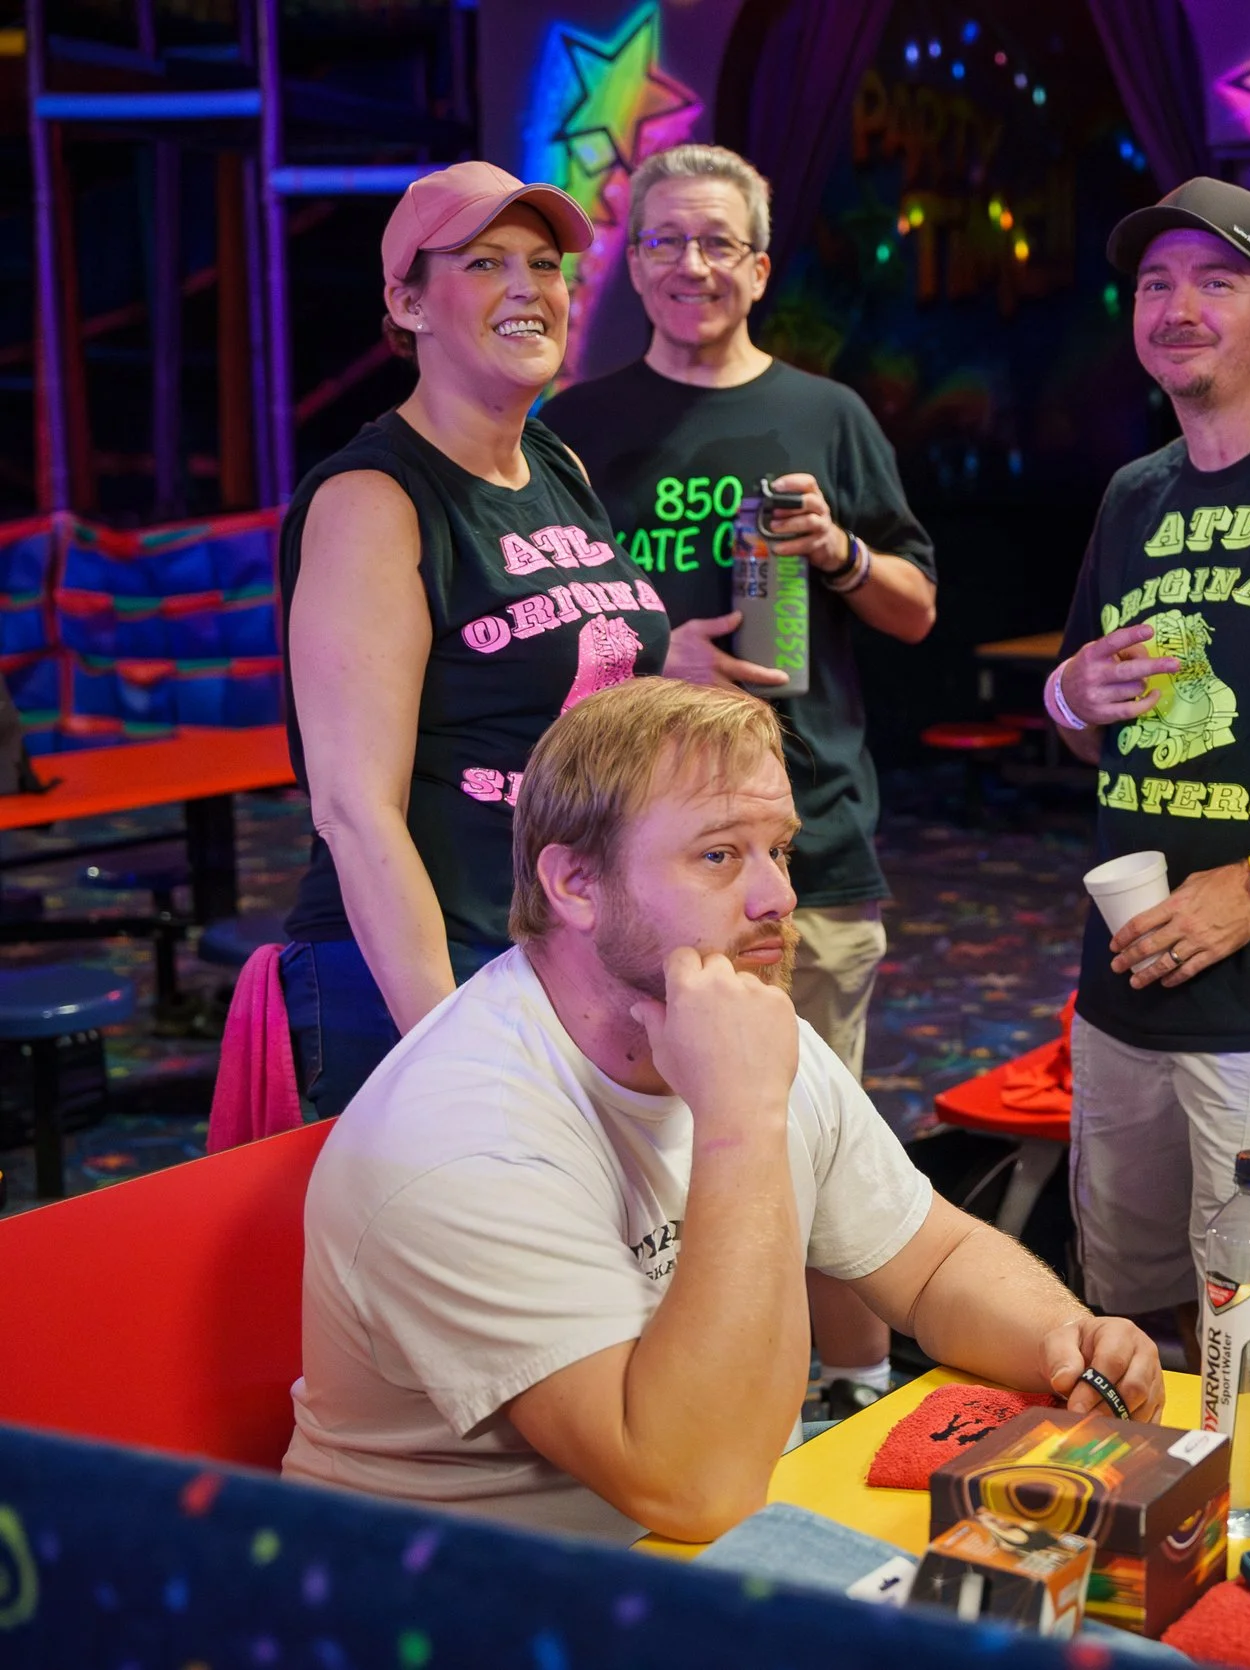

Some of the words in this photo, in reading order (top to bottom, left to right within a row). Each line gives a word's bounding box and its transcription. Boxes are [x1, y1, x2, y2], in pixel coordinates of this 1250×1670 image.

[655, 475, 743, 521] 850
[500, 524, 615, 576] ATL
[616, 526, 700, 572] ATE
[1093, 1375, 1108, 1390] DJ
